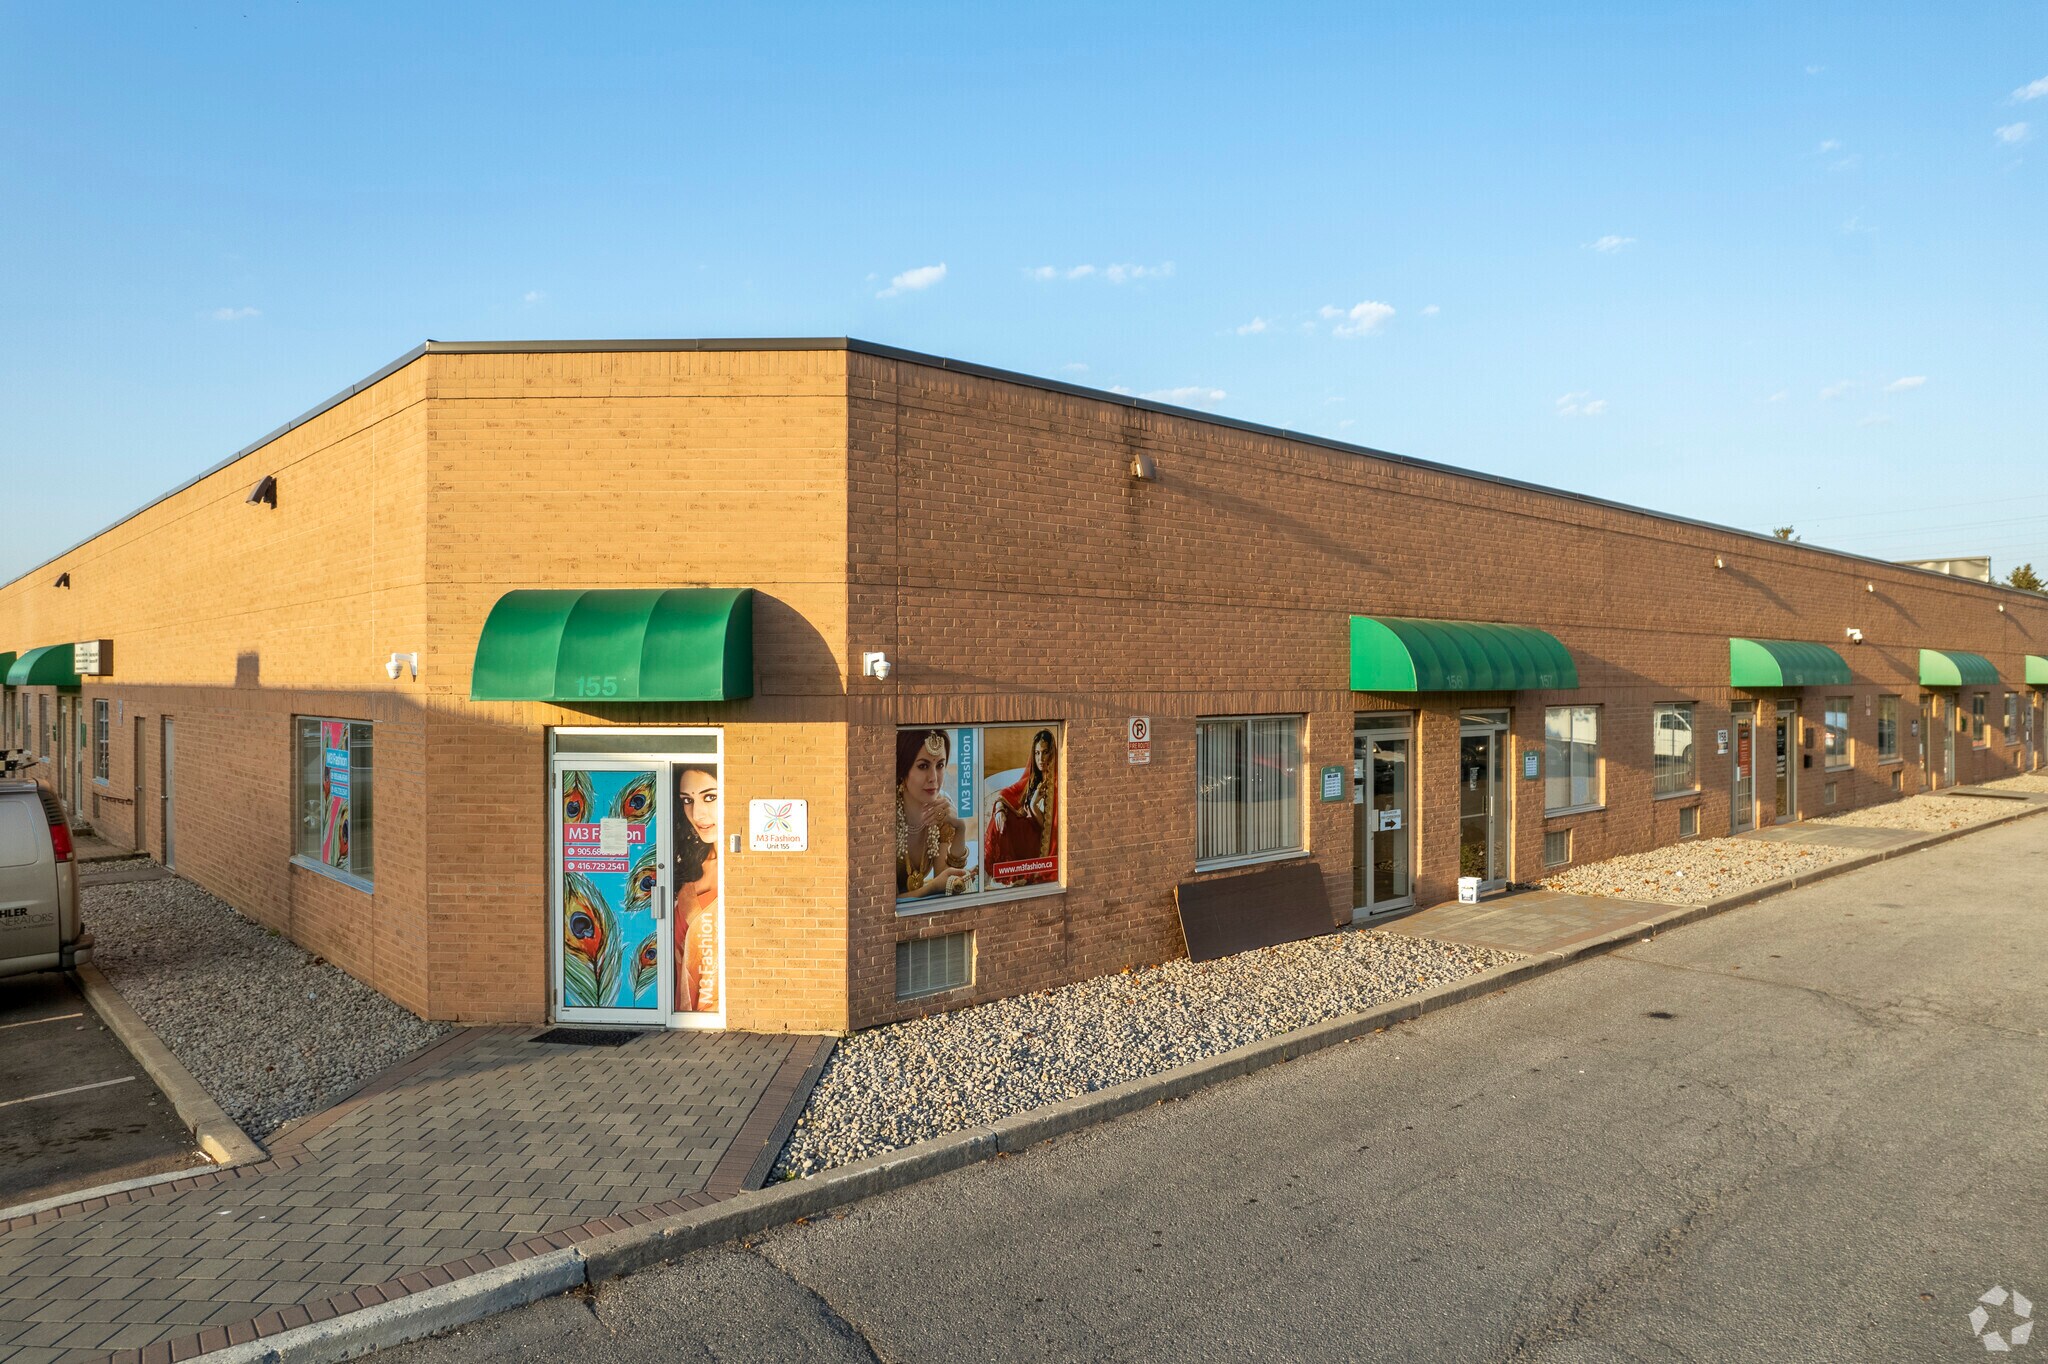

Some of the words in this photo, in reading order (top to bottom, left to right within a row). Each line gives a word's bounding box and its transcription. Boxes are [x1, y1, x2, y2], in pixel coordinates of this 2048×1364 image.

[576, 676, 618, 697] 155
[1446, 674, 1464, 689] 156
[1540, 674, 1553, 688] 157
[960, 735, 971, 787] Fashion
[961, 790, 971, 810] M3
[568, 827, 590, 840] M3
[756, 834, 769, 842] M3
[770, 834, 801, 843] Fashion
[577, 863, 625, 871] 416.729.2541
[999, 861, 1053, 874] www.m3fashion.ca
[697, 912, 713, 975] Fashion
[698, 979, 714, 1005] M3
